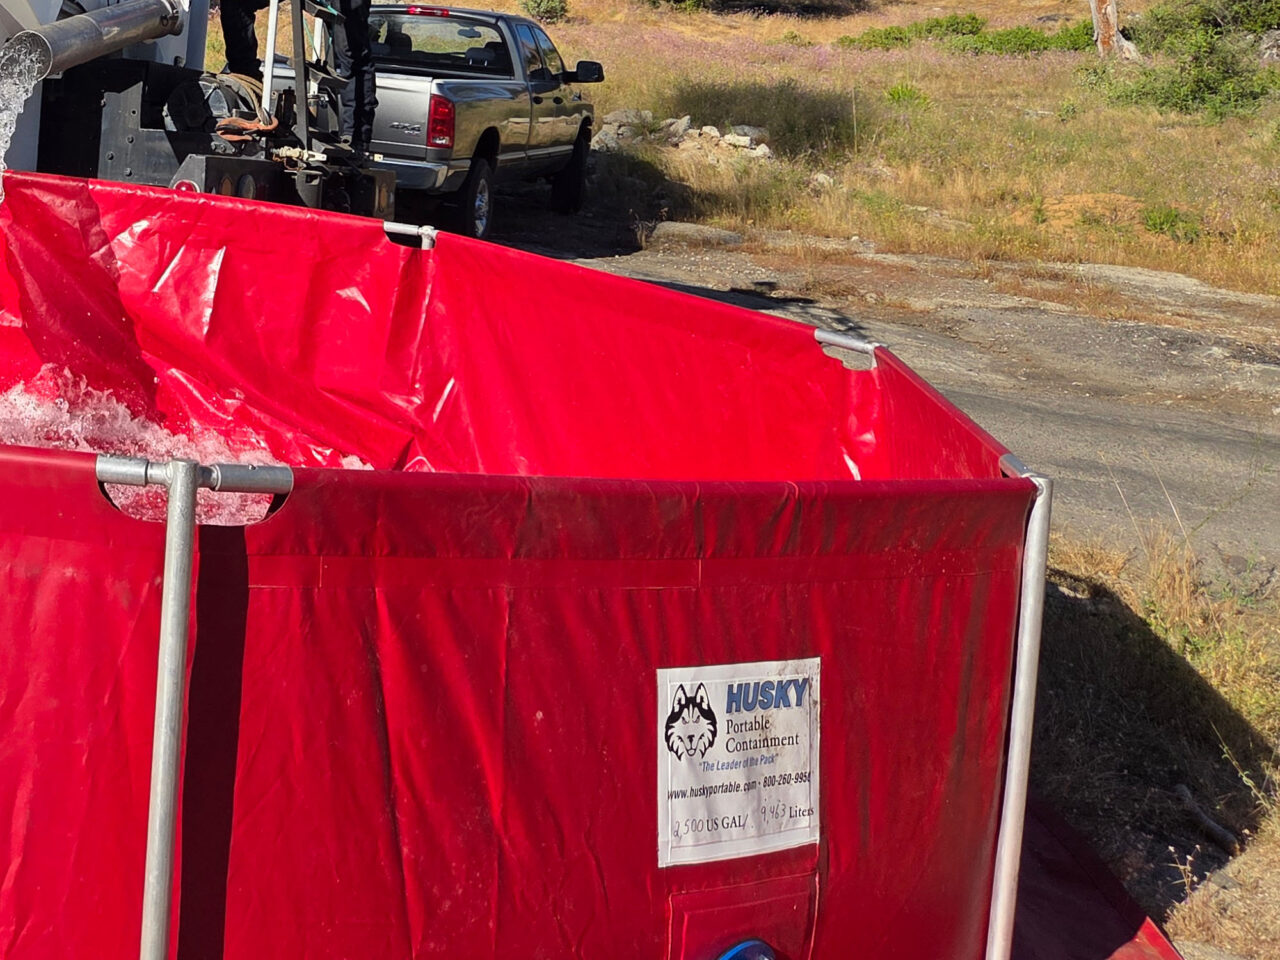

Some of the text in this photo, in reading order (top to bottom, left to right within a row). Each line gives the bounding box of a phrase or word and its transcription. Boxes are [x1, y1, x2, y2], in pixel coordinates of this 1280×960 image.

[725, 677, 810, 714] HUSKY
[726, 715, 770, 735] Portable
[725, 733, 800, 753] Containment
[716, 757, 741, 771] Leader
[667, 780, 757, 800] www.huskyportable.com
[673, 819, 704, 840] 2,500
[706, 817, 719, 832] US
[789, 805, 815, 818] Liters
